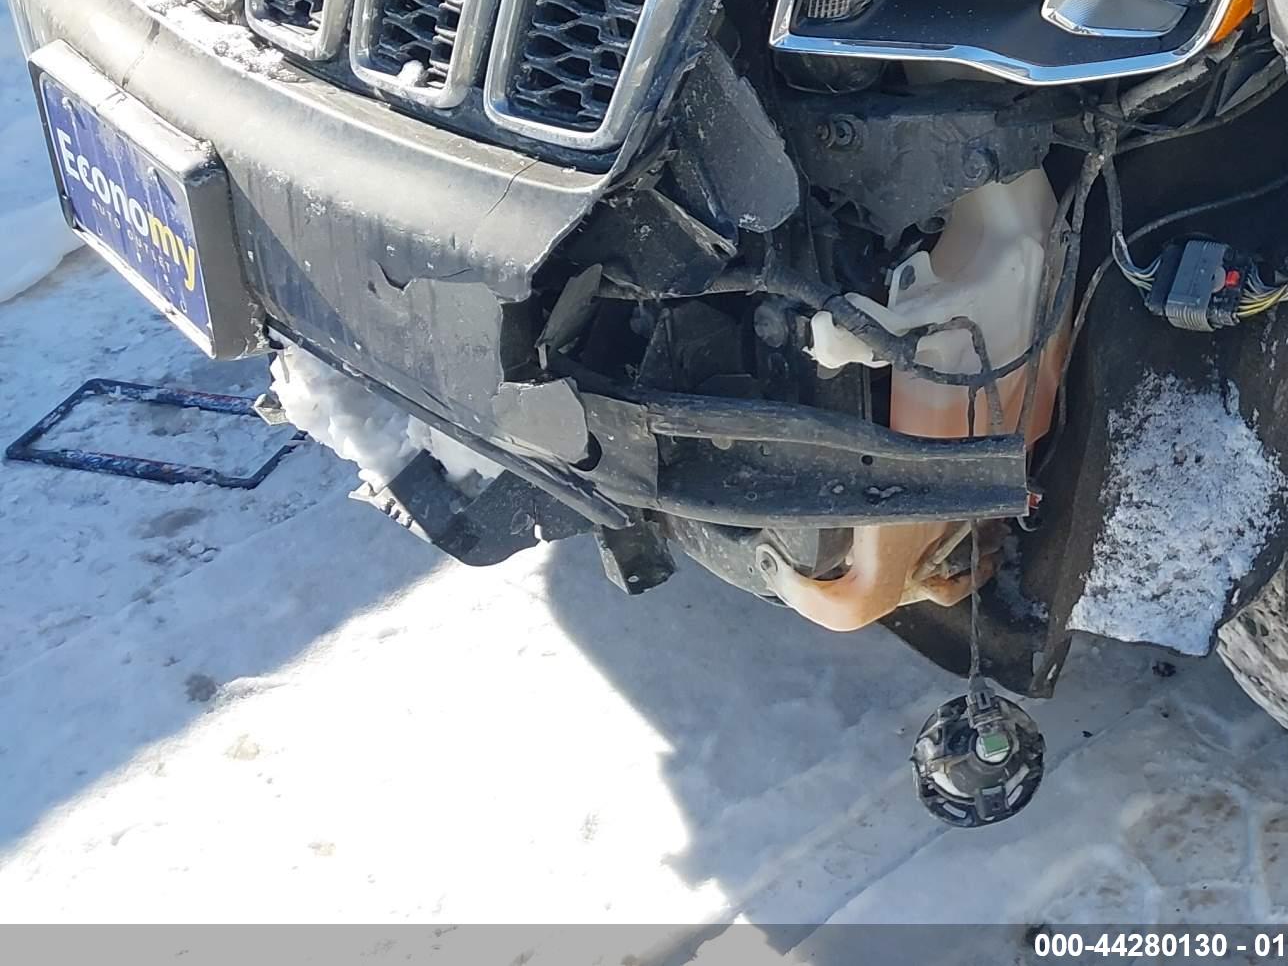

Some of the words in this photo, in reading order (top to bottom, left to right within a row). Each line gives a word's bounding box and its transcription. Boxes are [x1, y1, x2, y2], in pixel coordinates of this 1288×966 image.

[56, 128, 195, 292] Economy
[91, 198, 121, 230] AUTO
[126, 229, 171, 274] OUTLET
